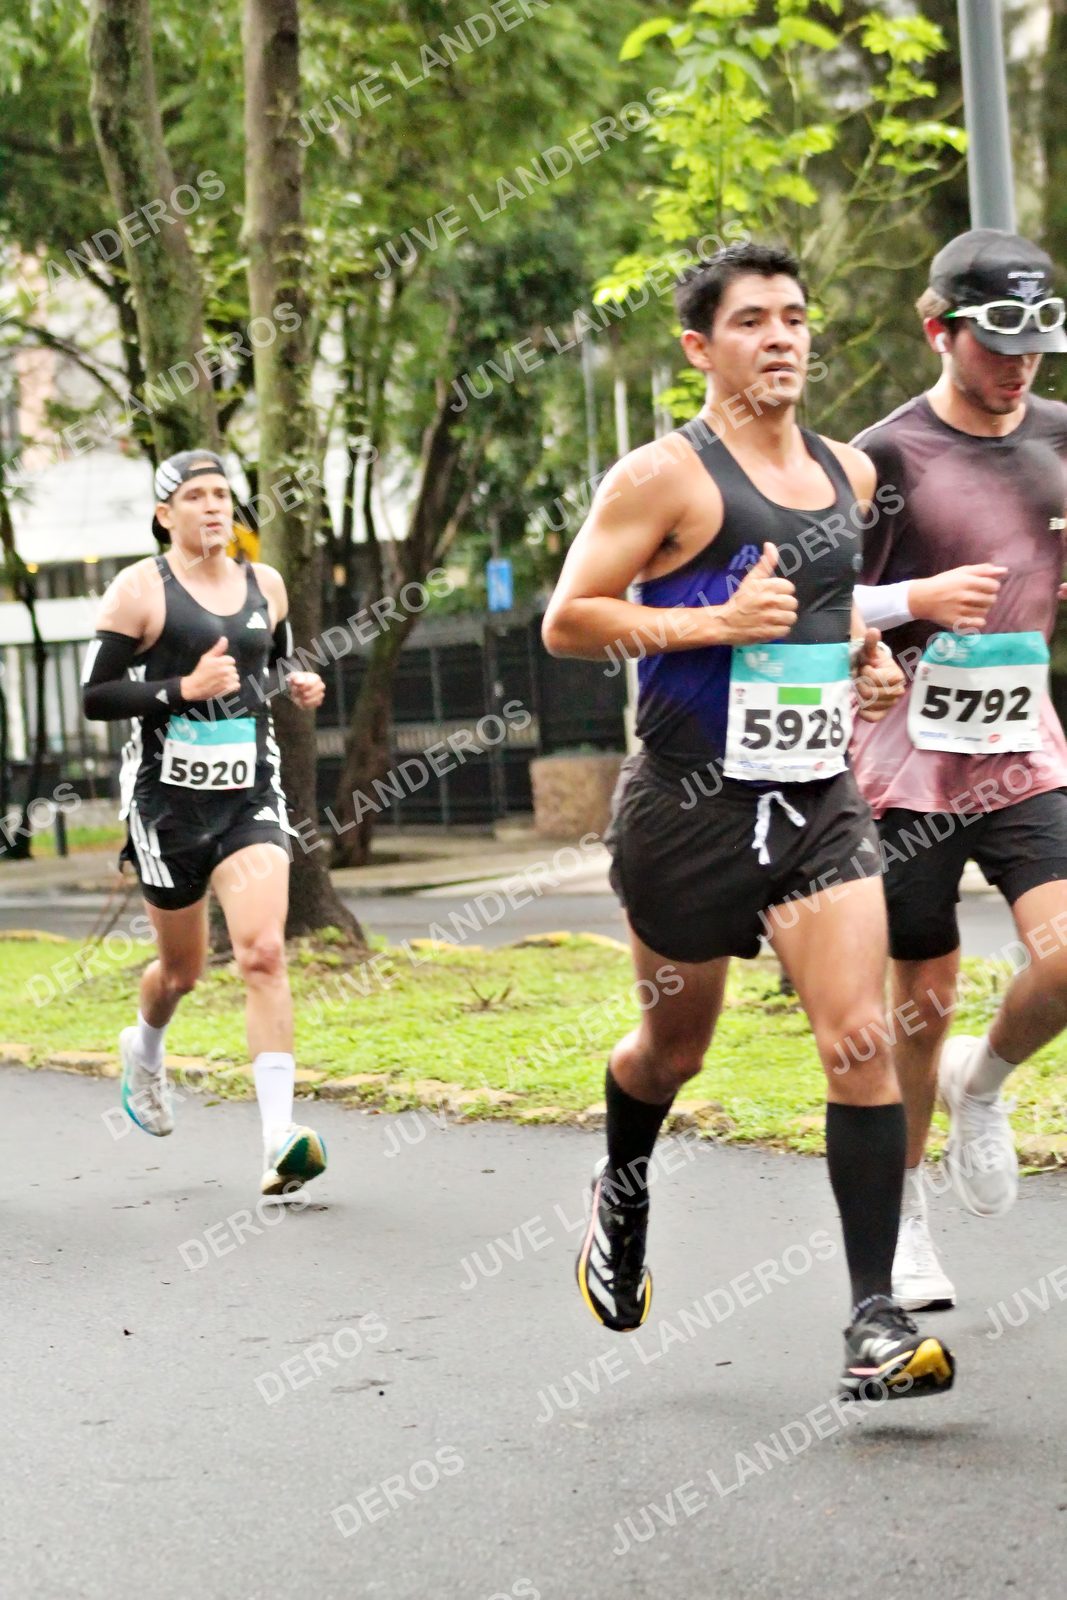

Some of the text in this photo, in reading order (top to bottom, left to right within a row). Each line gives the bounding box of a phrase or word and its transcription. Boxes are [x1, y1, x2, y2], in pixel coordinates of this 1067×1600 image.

[920, 684, 1032, 724] 5792
[739, 707, 844, 751] 5928
[168, 756, 248, 786] 5920
